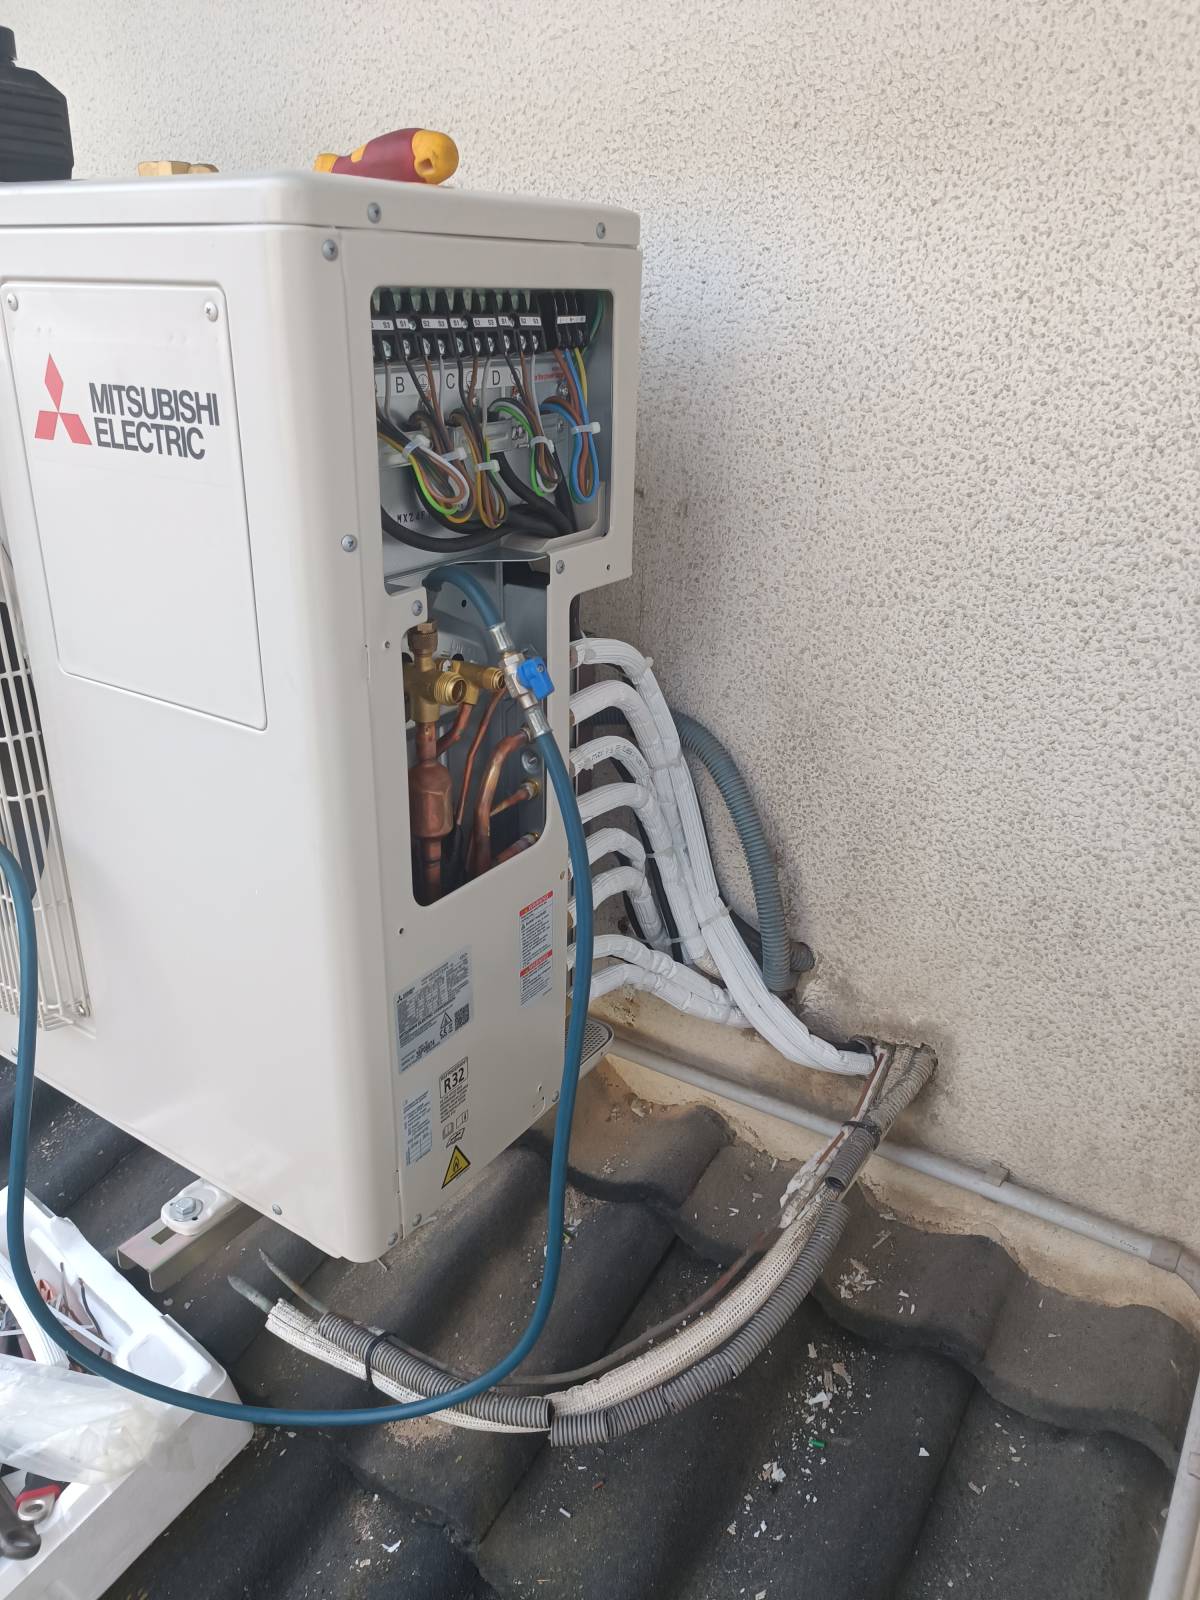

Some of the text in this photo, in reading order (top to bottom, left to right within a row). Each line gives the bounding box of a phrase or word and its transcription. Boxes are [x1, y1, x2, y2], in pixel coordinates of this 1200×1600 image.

[395, 370, 501, 393] B C D
[89, 382, 220, 427] MITSUBISHI
[94, 417, 206, 460] ELECTRIC
[444, 1067, 464, 1093] R32
